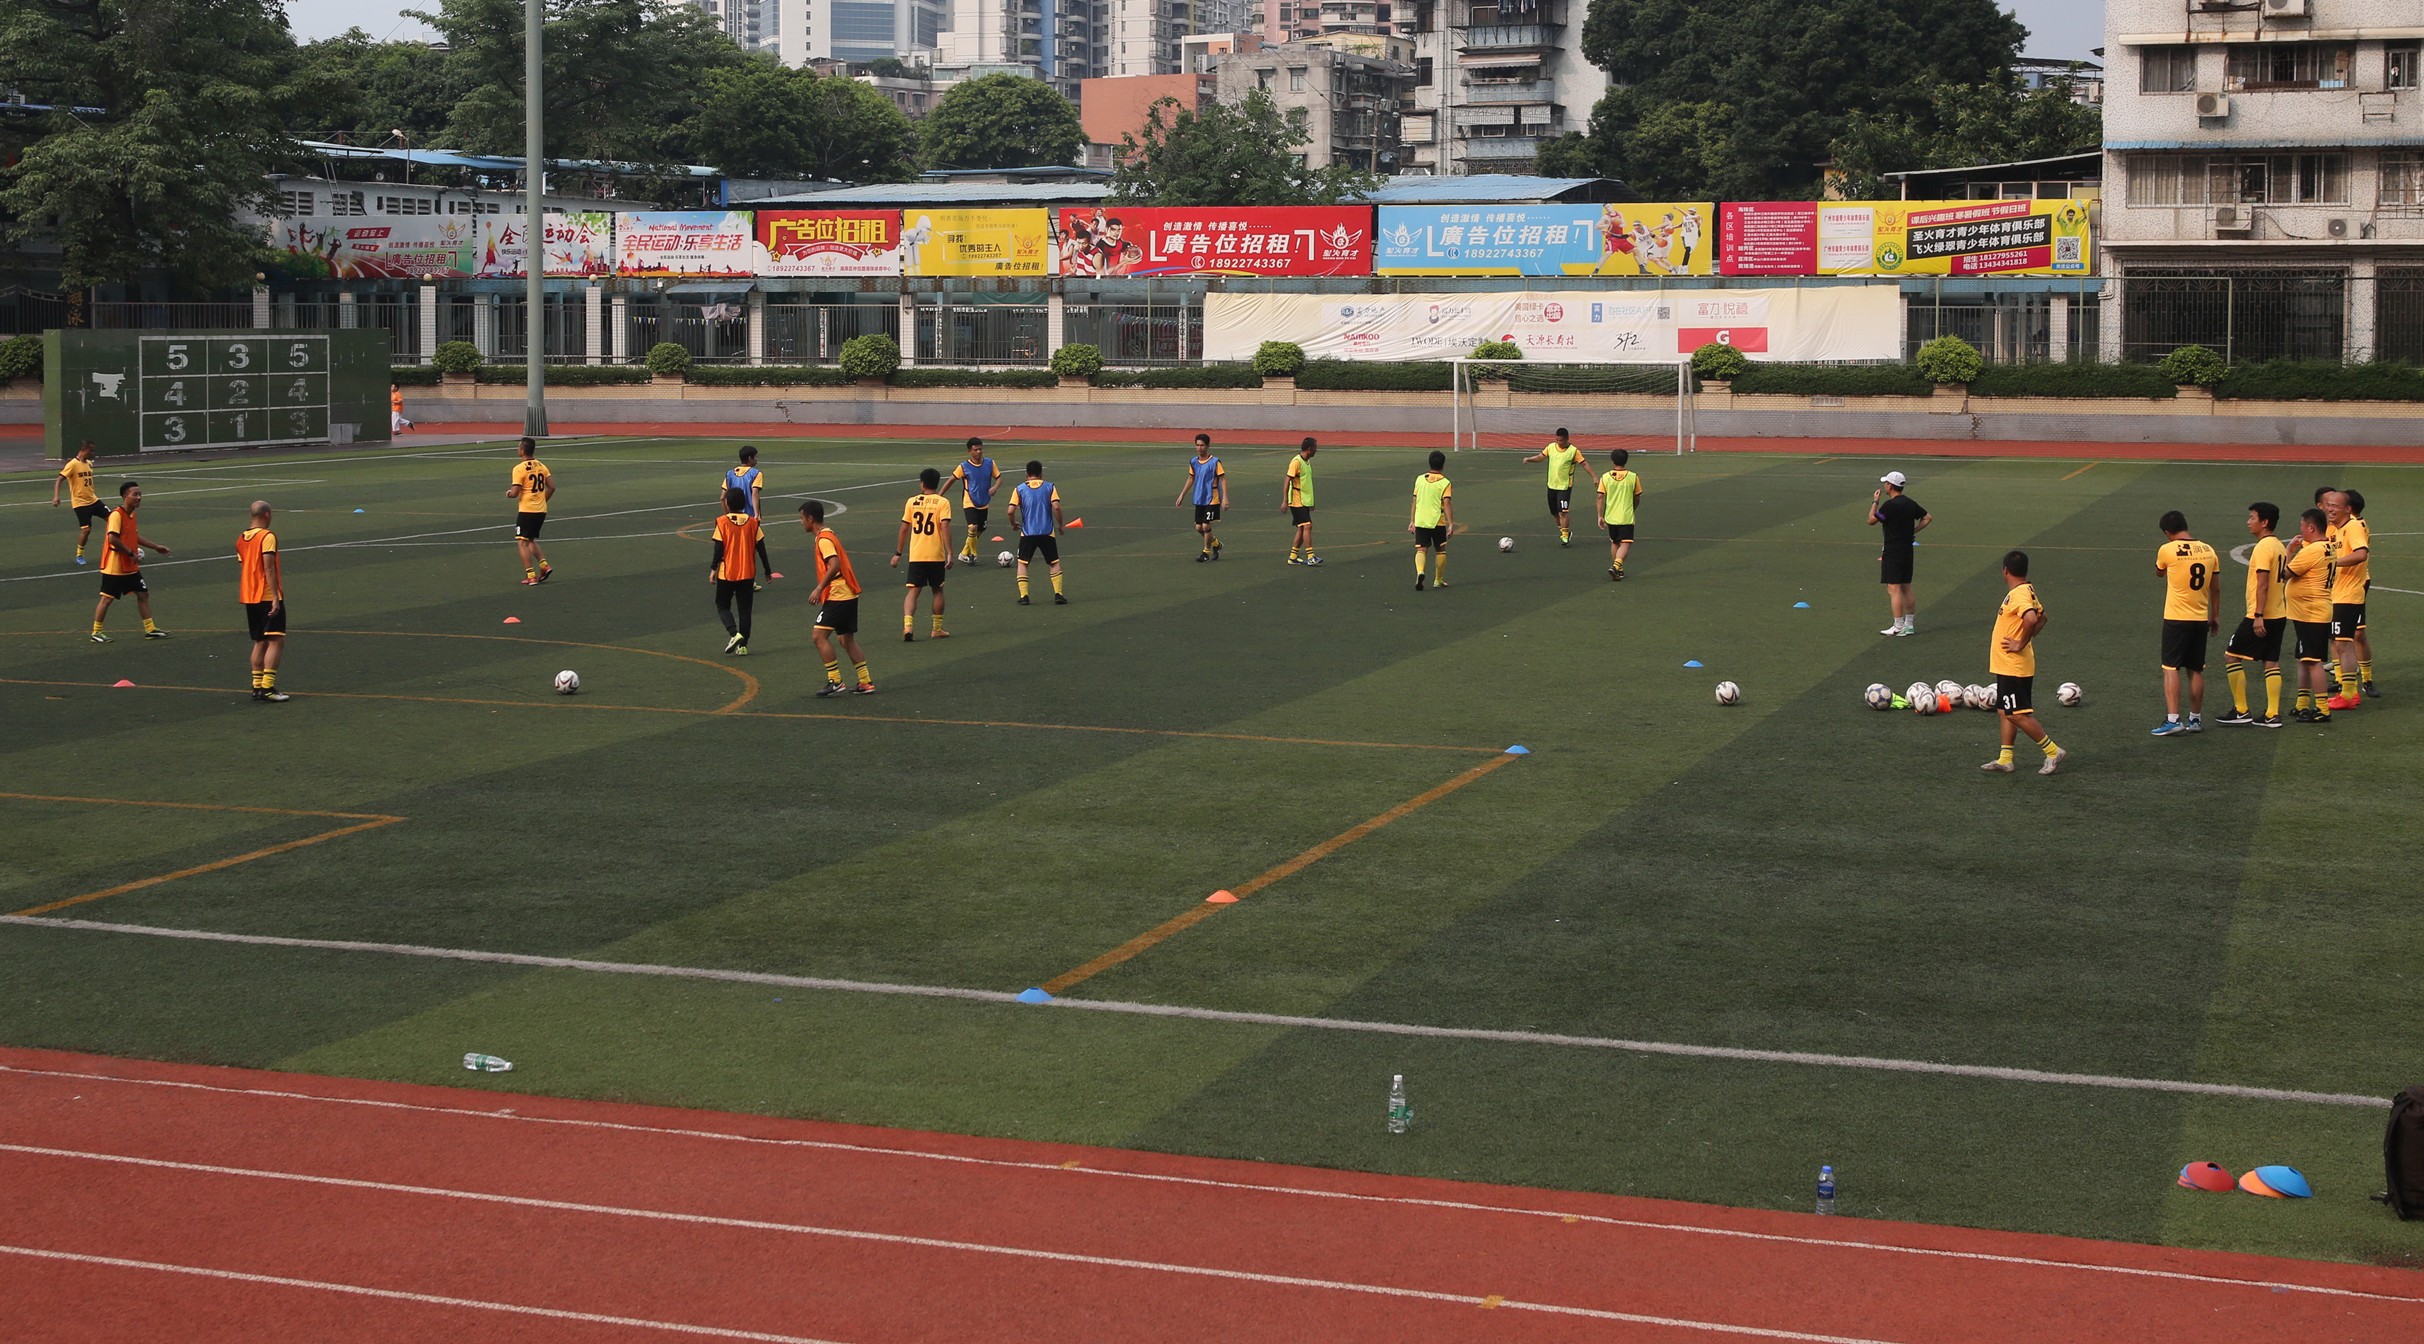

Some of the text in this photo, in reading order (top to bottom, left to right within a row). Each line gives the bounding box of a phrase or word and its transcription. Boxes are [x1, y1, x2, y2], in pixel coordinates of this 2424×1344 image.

[1991, 204, 2027, 216] 节假日班
[500, 222, 598, 245] 全运动会
[767, 216, 889, 252] 广告位招租
[1163, 221, 1203, 231] 创造激情
[1912, 218, 2045, 242] 圣火育才青少年体育俱乐部
[1725, 211, 1735, 263] 各区培训点
[1912, 232, 2045, 255] 飞火绿翠青少年体育俱乐部
[959, 243, 1001, 253] 优秀的主人
[1464, 248, 1545, 259] 18922743367
[1979, 251, 2028, 261] 18127955261
[1209, 258, 1291, 268] 18922743367
[1979, 258, 2028, 269] 13434341818
[1716, 330, 1730, 346] G
[167, 343, 309, 370] 5 3 5
[164, 378, 308, 406] 4 2 4
[164, 411, 309, 442] 3 1 3
[529, 473, 545, 493] 28
[913, 511, 935, 536] 36
[2190, 562, 2206, 591] 8
[2331, 621, 2341, 635] 15
[2003, 693, 2017, 710] 31
